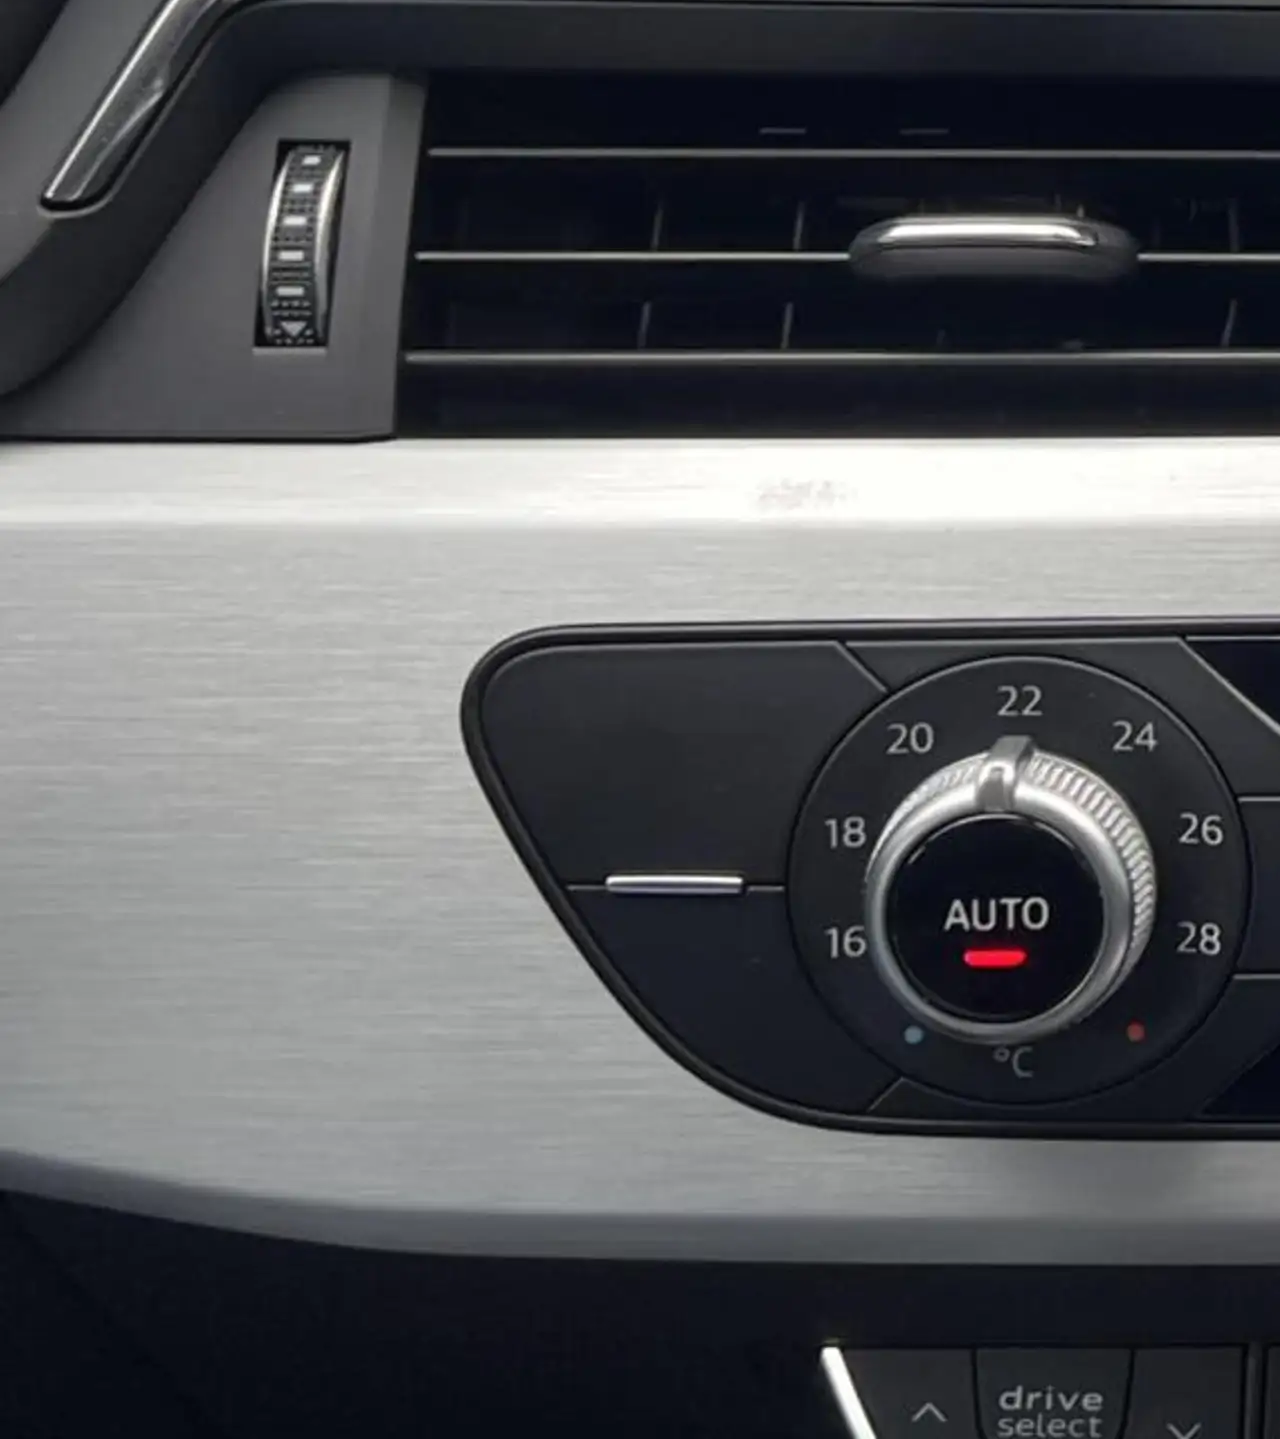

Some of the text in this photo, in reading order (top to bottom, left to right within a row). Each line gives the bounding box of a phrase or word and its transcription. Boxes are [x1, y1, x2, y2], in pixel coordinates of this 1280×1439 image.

[996, 686, 1042, 716] 22
[886, 723, 934, 754] 20
[1112, 721, 1158, 751] 24
[825, 817, 866, 848] 18
[1179, 813, 1223, 845] 26
[944, 897, 1050, 931] AUTO
[826, 926, 866, 958] 16
[1178, 922, 1222, 955] 28
[993, 1047, 1034, 1078] °C
[998, 1386, 1104, 1411] drive
[998, 1413, 1101, 1438] select
